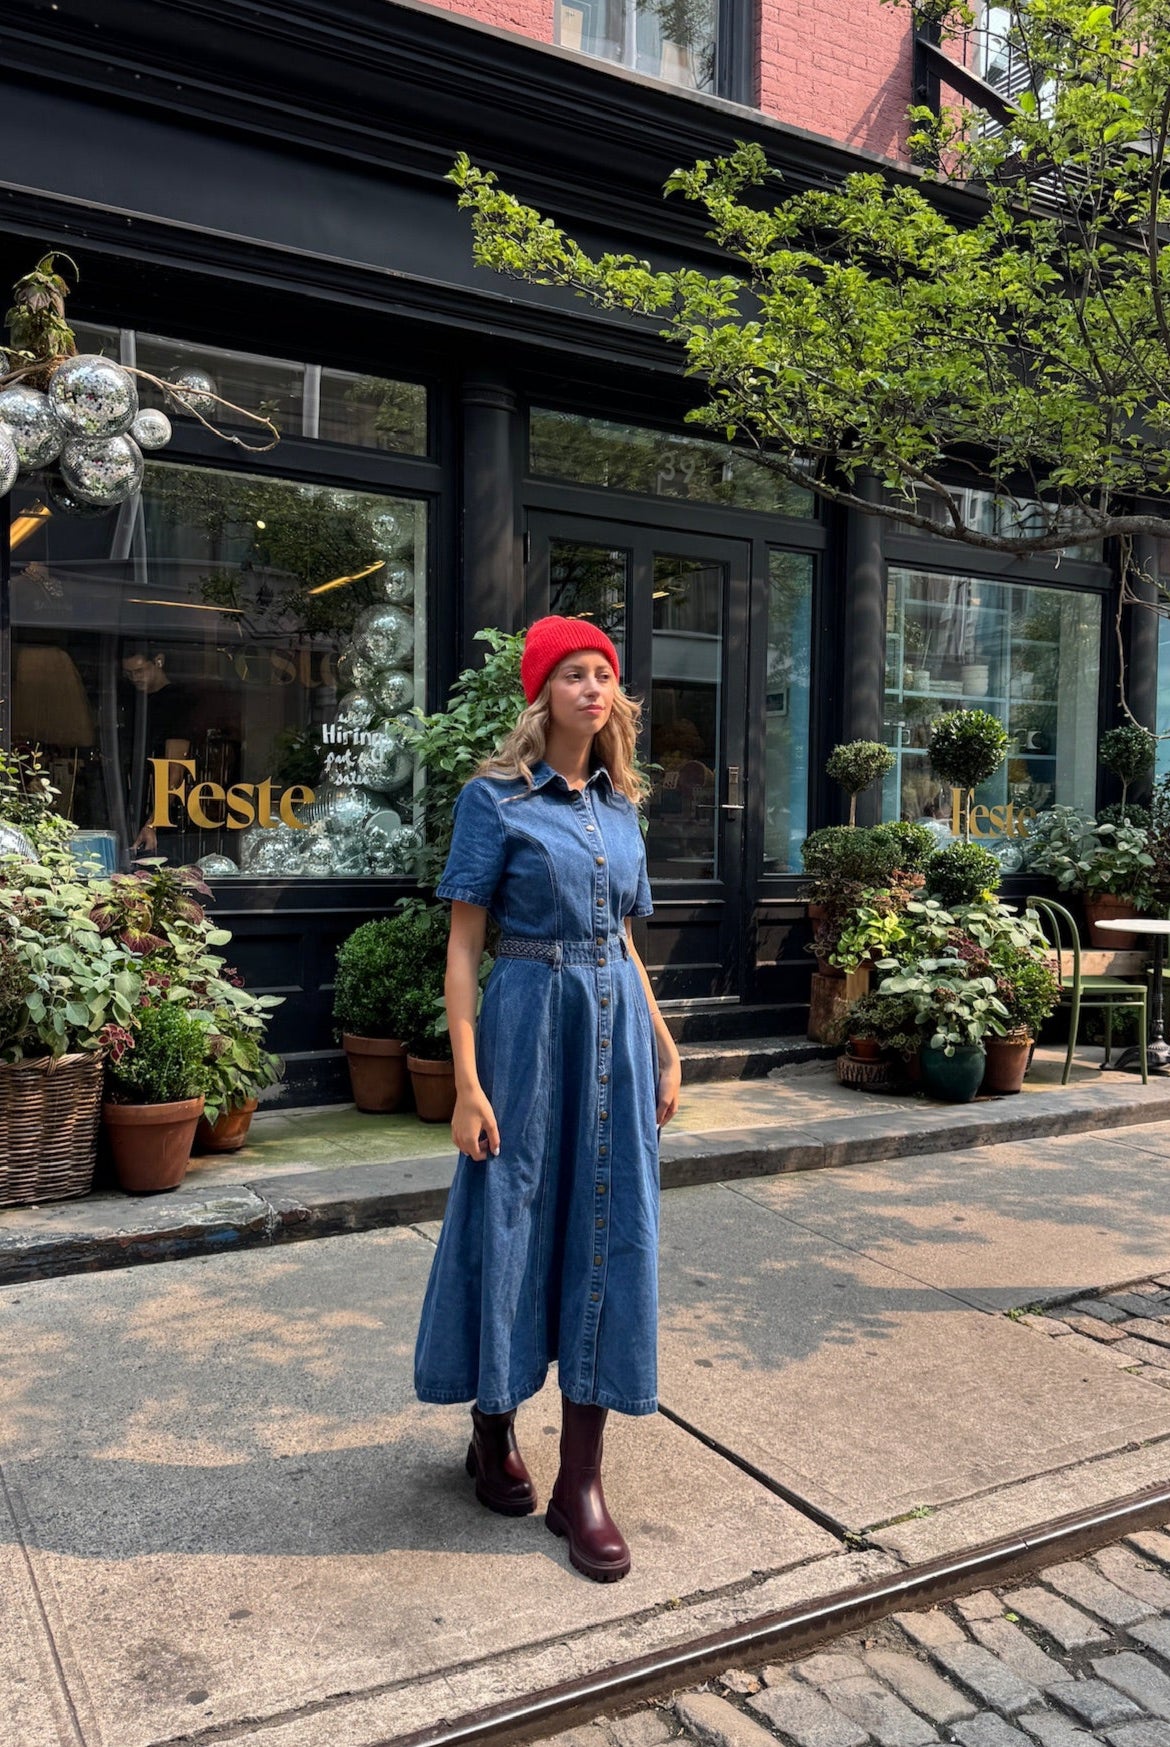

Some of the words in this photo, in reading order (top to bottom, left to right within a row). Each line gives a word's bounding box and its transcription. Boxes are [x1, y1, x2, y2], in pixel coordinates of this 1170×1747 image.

[659, 450, 696, 483] 39
[147, 757, 316, 830] Feste
[950, 787, 1037, 839] Feste
